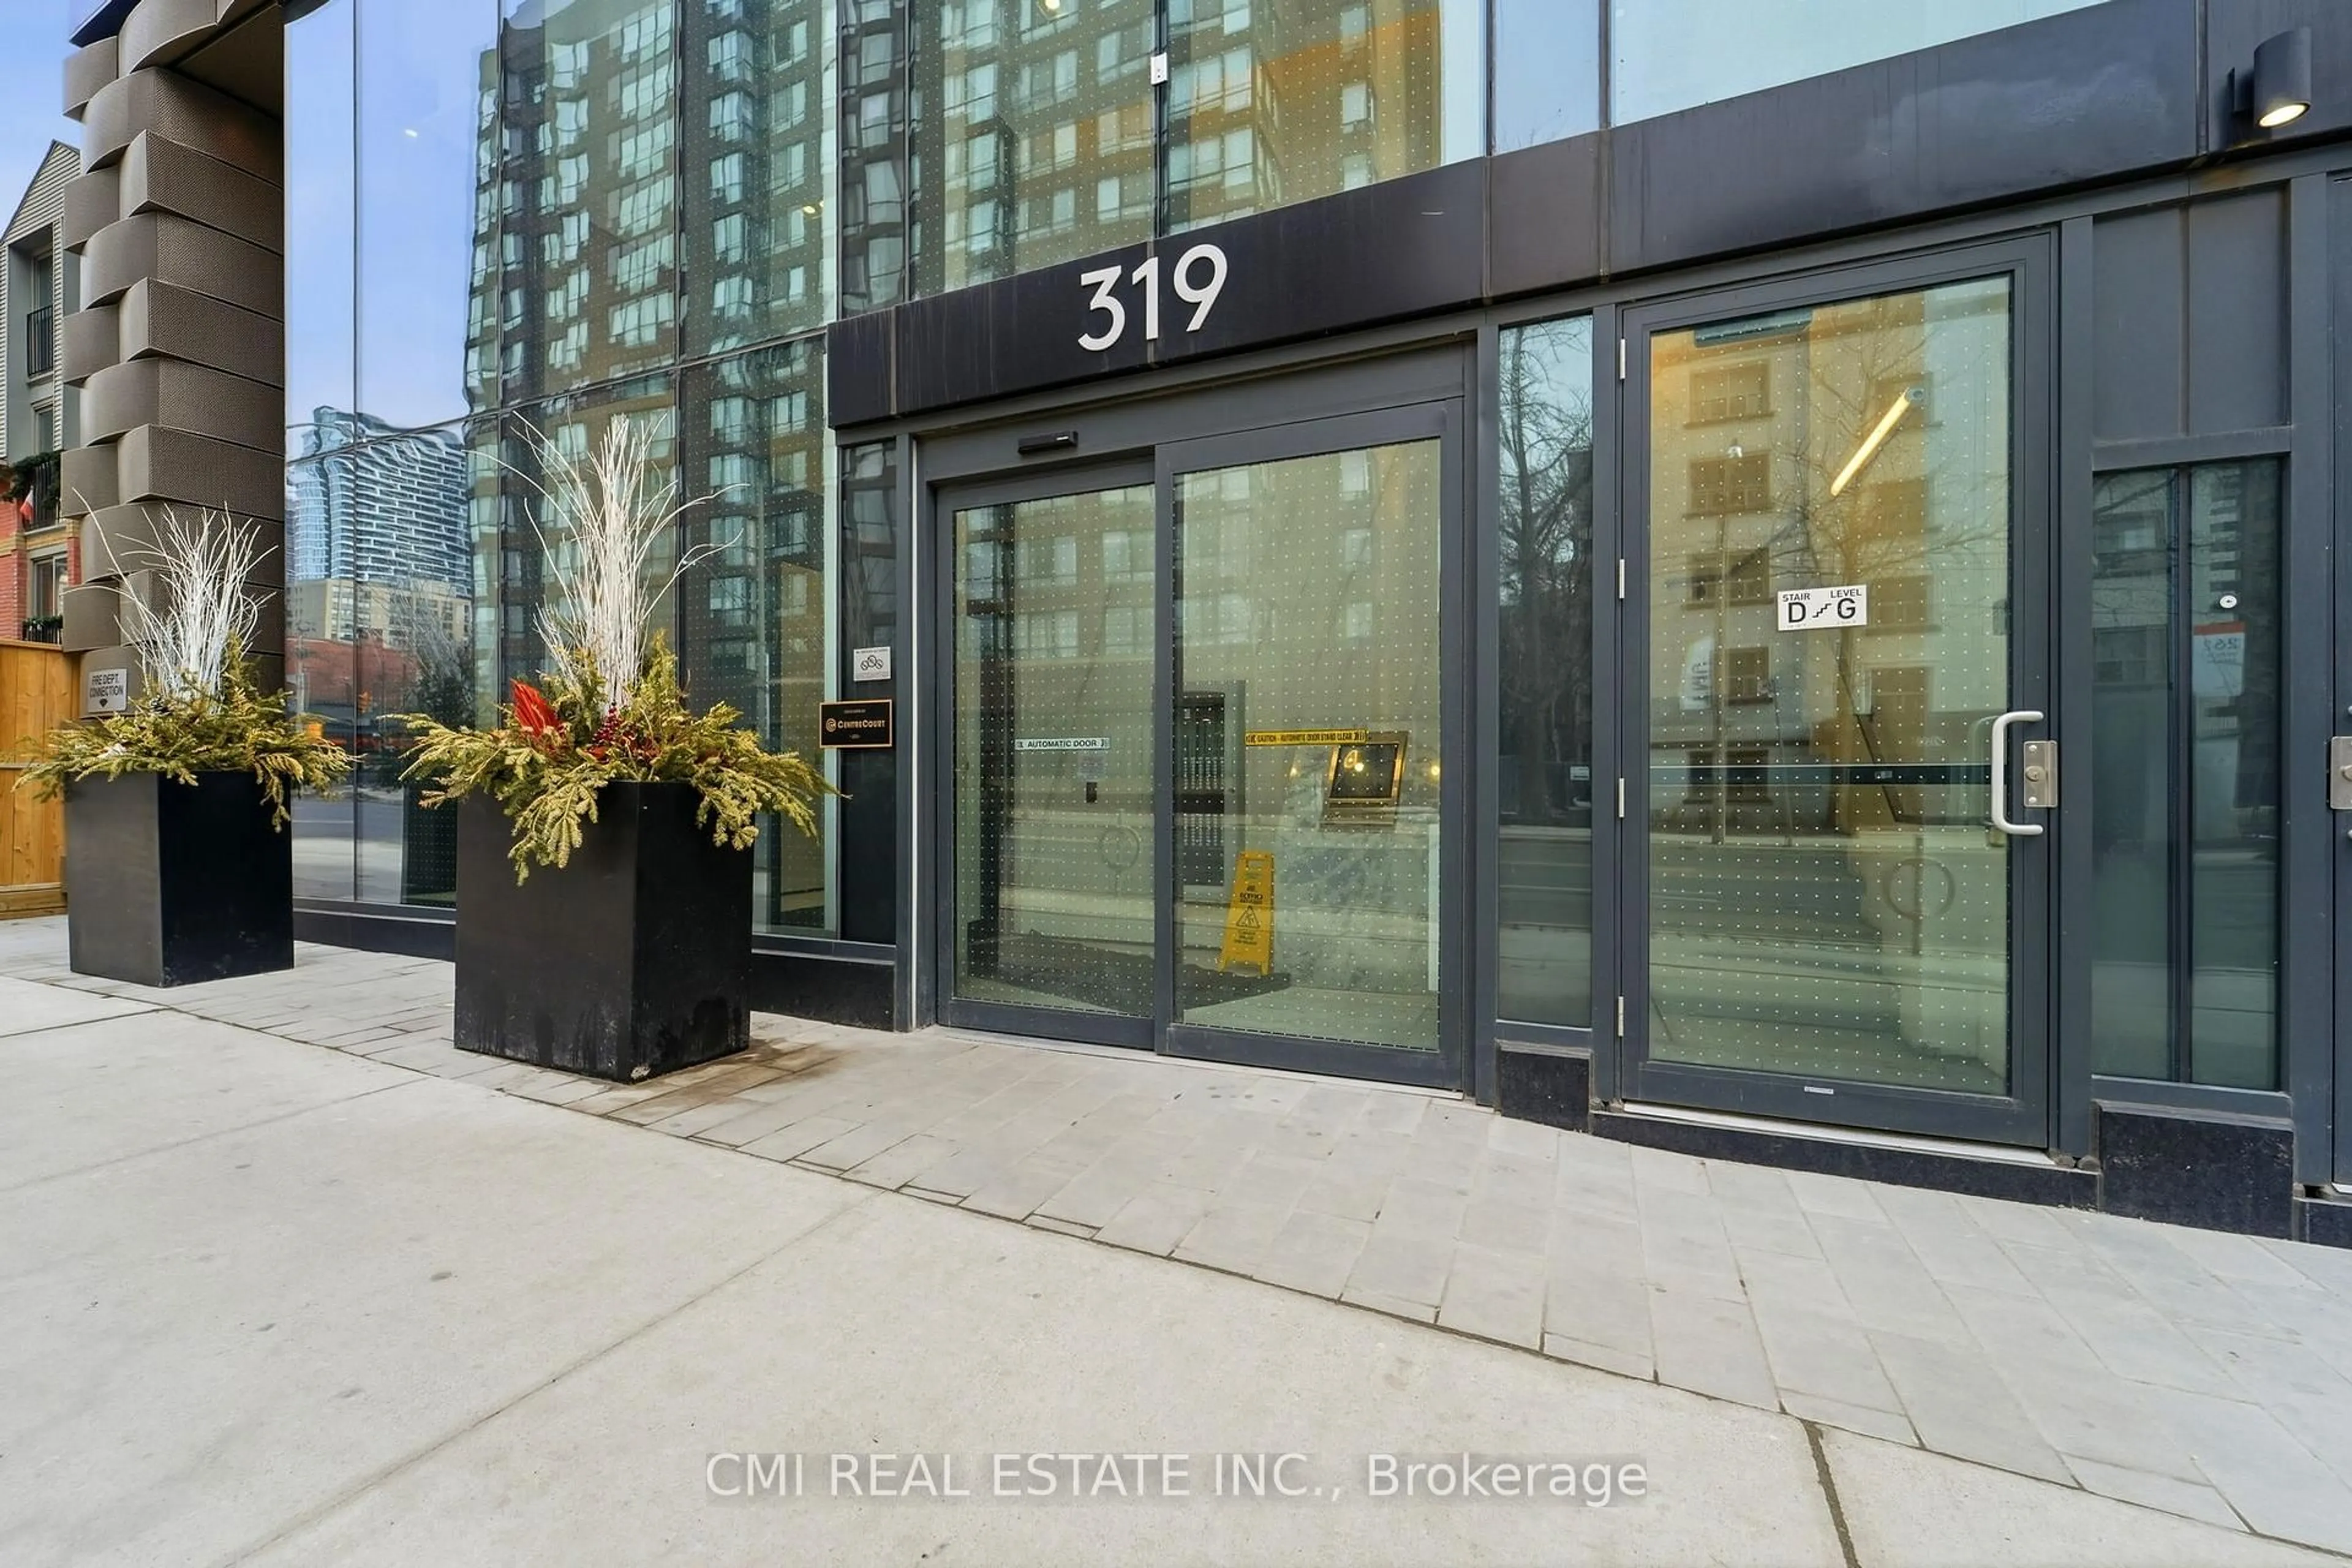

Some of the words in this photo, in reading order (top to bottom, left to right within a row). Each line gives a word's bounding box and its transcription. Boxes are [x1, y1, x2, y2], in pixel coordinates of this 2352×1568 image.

[1077, 243, 1228, 352] 319
[1782, 593, 1811, 602] STAIR
[1830, 589, 1862, 598] LEVEL
[1788, 601, 1806, 624] D
[1838, 597, 1856, 619] G
[89, 685, 123, 698] CONNECTION
